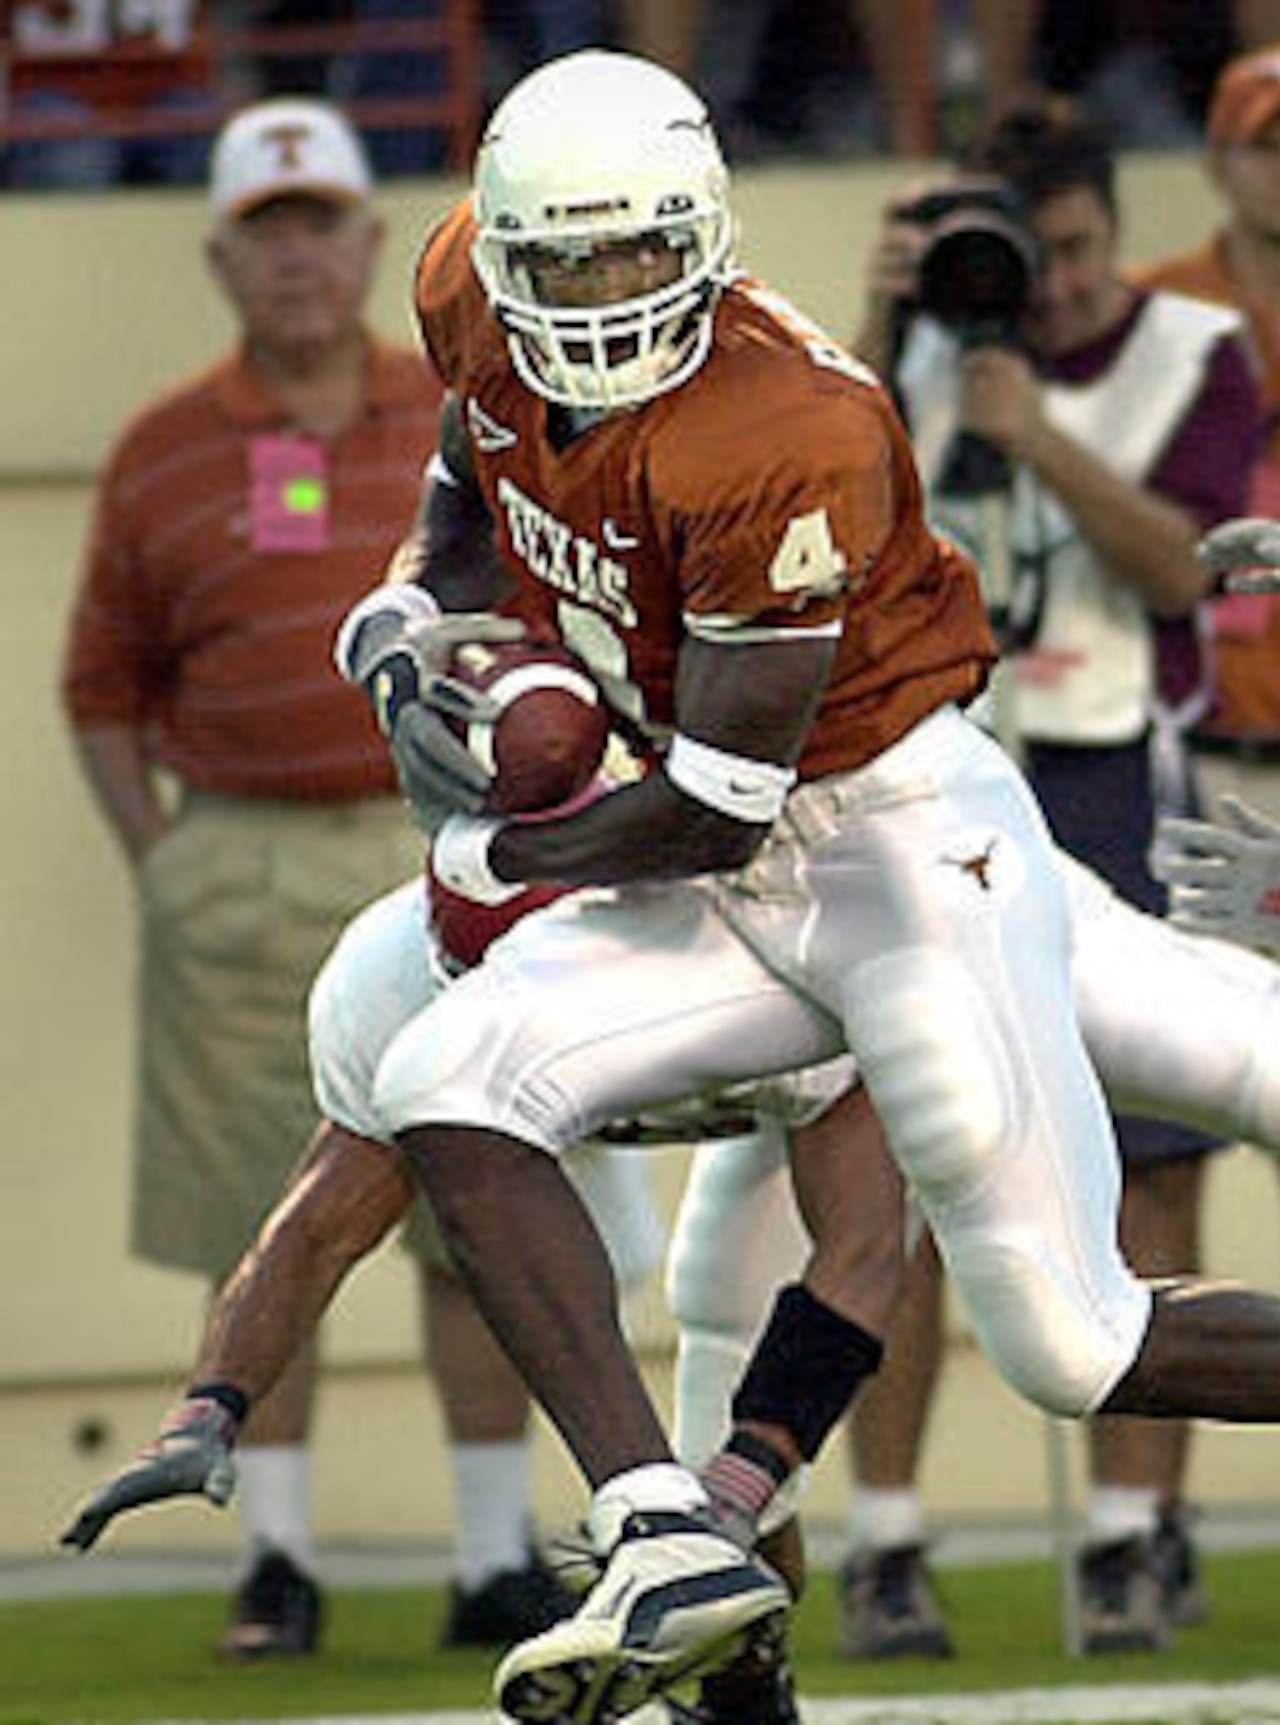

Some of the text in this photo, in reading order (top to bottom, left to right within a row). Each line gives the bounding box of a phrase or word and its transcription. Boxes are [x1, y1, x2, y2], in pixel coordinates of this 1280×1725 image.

[261, 122, 313, 169] T
[497, 476, 639, 629] TEXAS
[767, 506, 849, 612] 4
